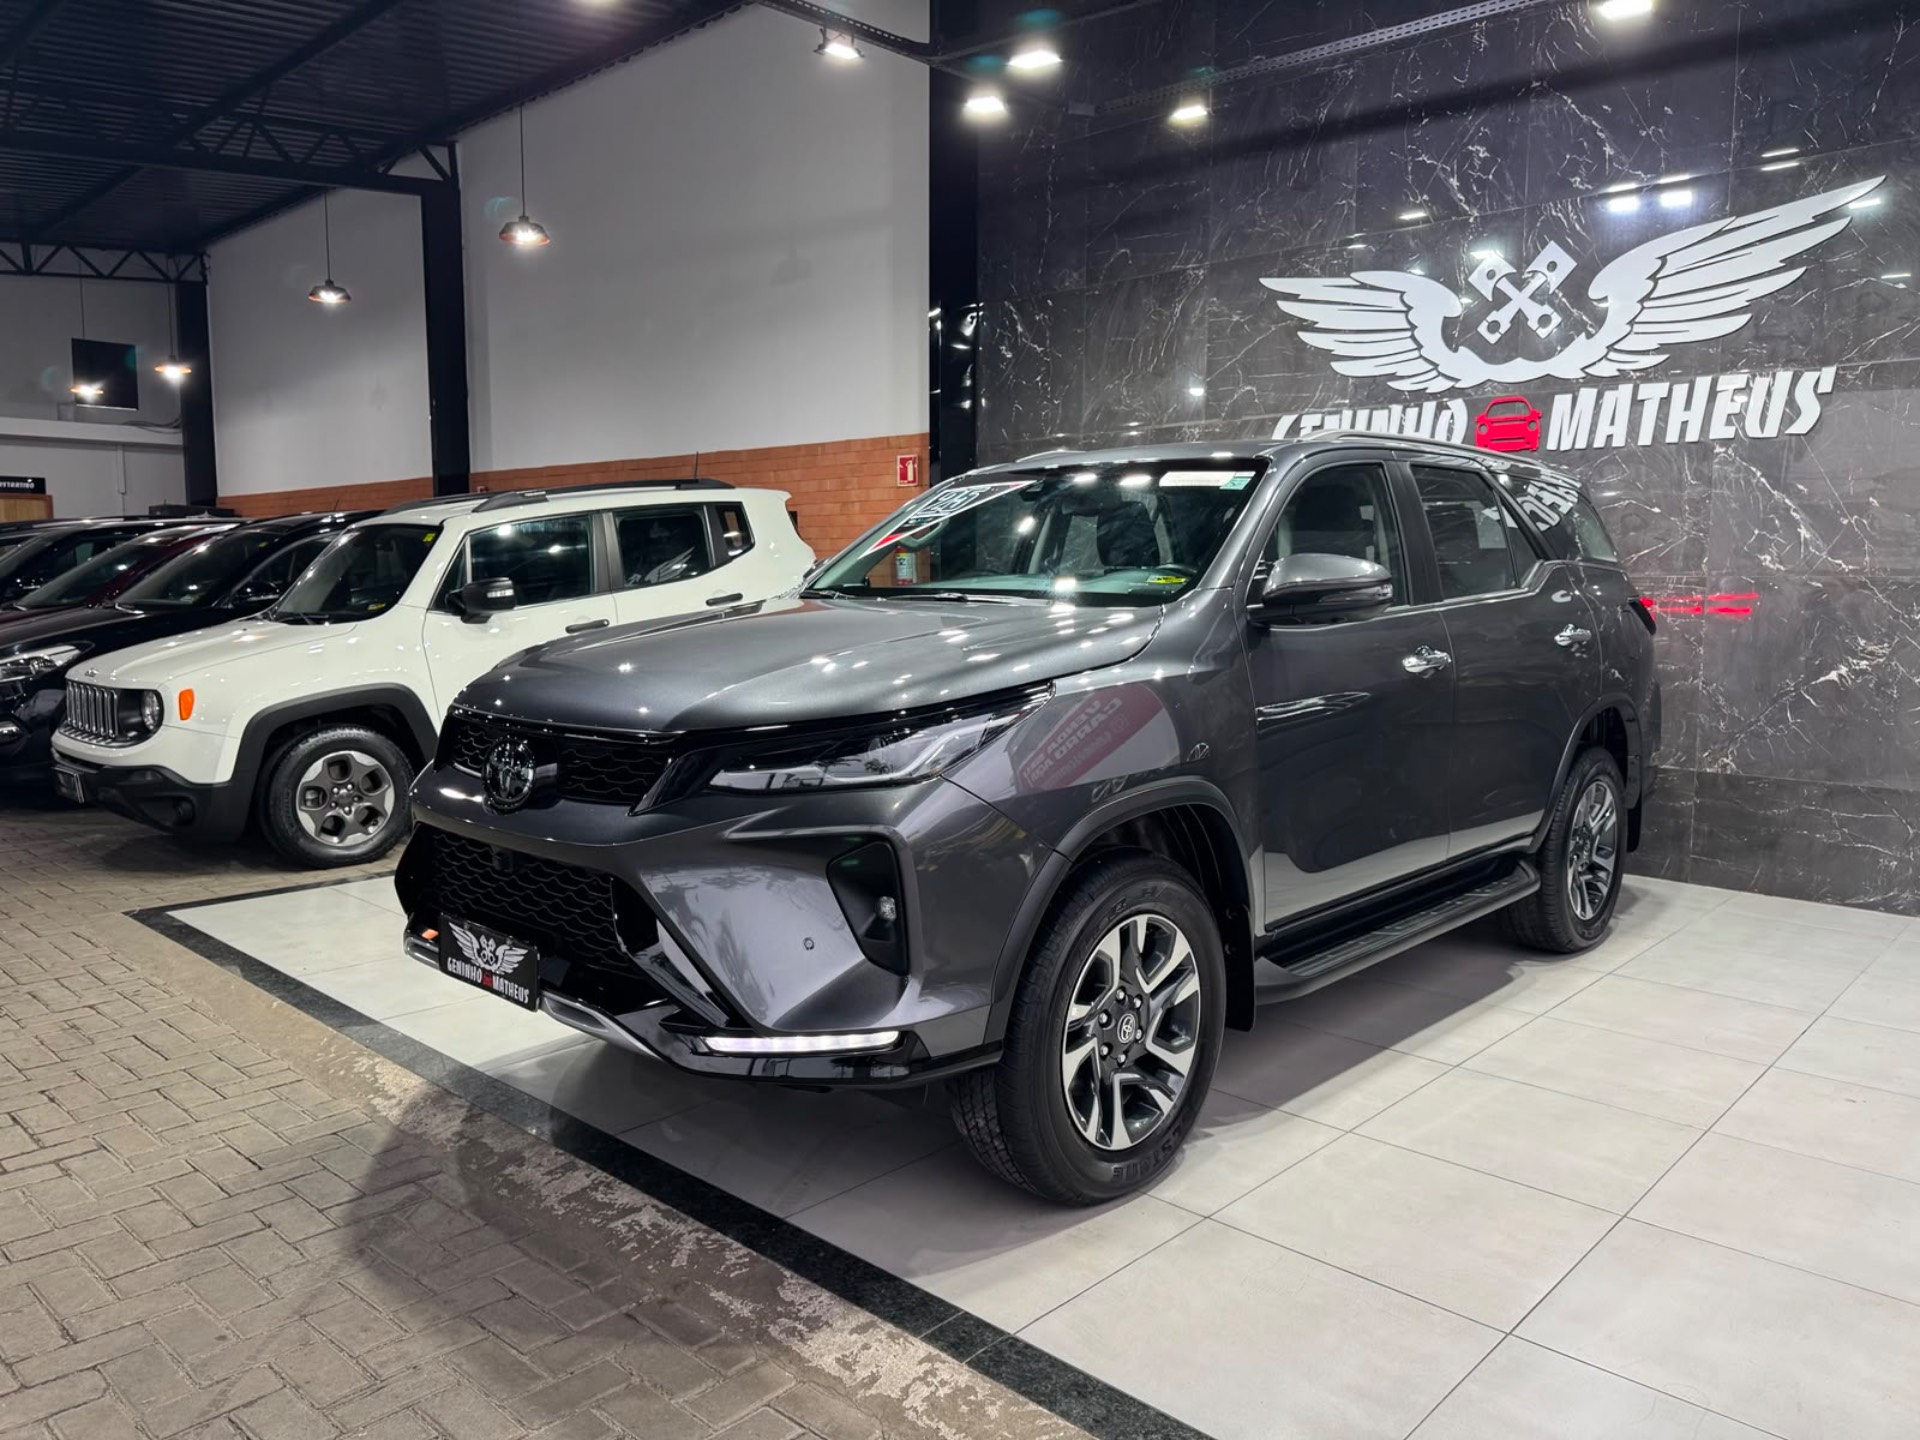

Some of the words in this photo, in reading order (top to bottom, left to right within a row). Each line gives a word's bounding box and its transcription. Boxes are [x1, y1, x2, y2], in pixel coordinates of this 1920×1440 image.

[1546, 365, 1837, 451] MATHEUS
[447, 957, 482, 983] GENINHO
[492, 974, 529, 1004] MATHEUS
